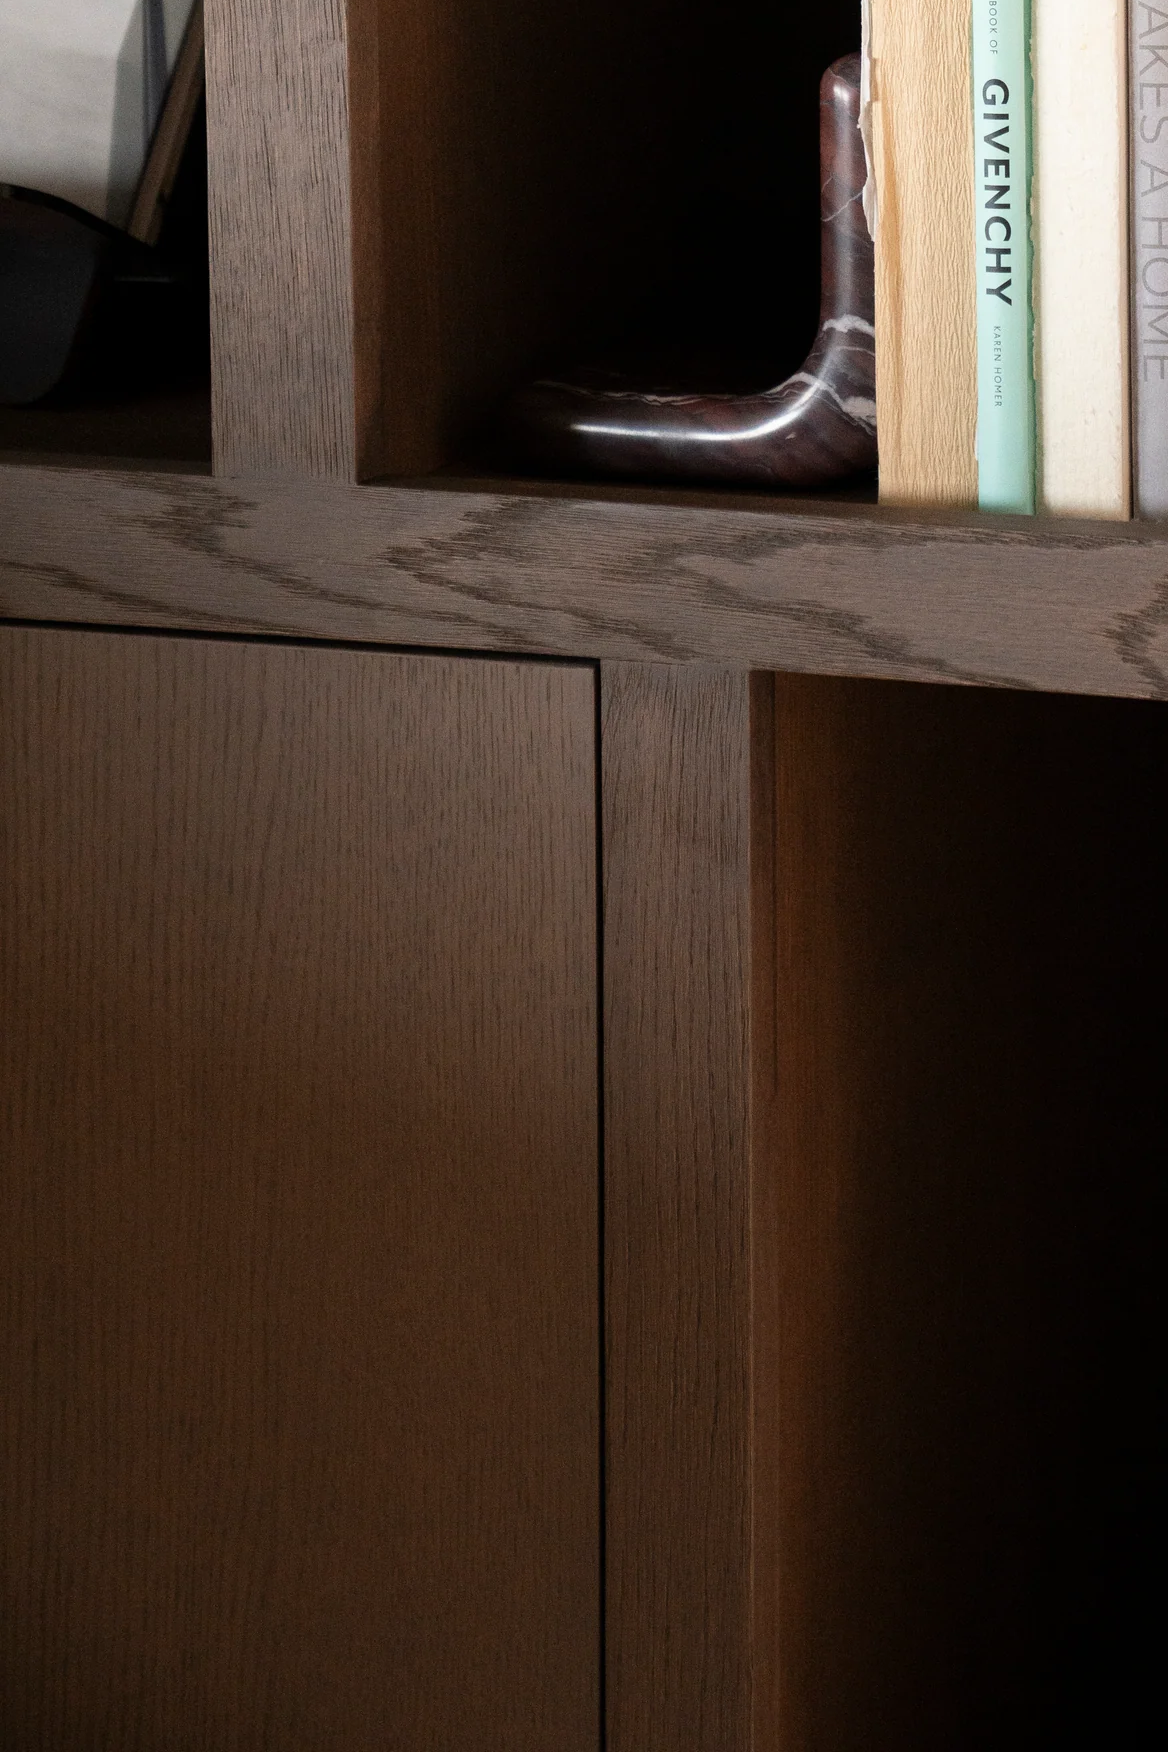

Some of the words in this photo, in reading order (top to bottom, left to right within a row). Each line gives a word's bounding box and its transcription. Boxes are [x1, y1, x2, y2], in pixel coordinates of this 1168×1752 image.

[988, 0, 998, 34] BOOK
[989, 39, 998, 55] OF
[982, 78, 1012, 306] GIVENCHY
[993, 325, 1002, 362] KAREN
[993, 367, 1003, 407] HOMER
